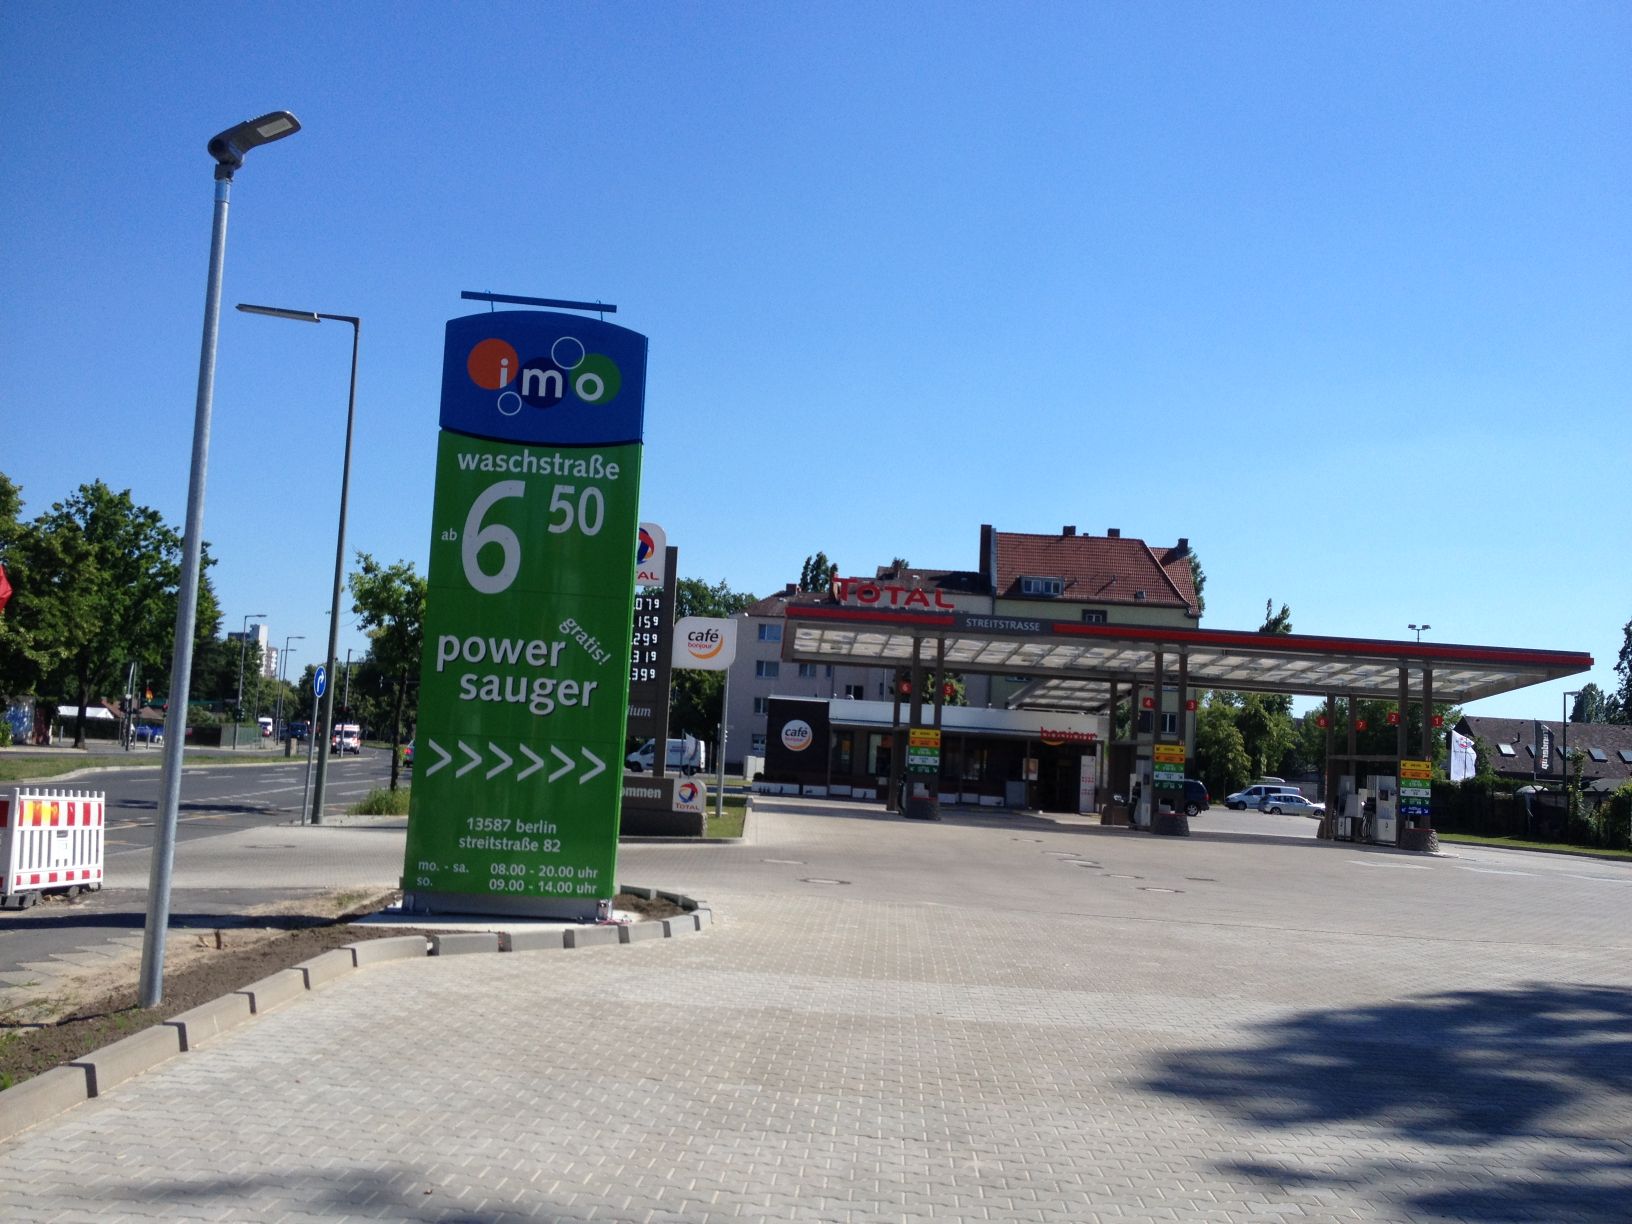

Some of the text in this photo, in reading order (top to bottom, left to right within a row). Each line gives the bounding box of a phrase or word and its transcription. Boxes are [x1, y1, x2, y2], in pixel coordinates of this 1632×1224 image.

[499, 358, 605, 401] imo
[457, 449, 620, 480] waschstraße
[441, 480, 605, 594] ab 6 50
[833, 577, 955, 609] TOTAL
[965, 618, 1041, 631] STREITSTRASSE
[559, 618, 611, 666] gratis!
[687, 628, 720, 643] café
[436, 634, 567, 673] power
[687, 642, 712, 650] bonjour
[459, 673, 598, 715] sauger
[784, 726, 808, 738] café
[675, 802, 700, 810] TOTAL
[466, 817, 557, 834] 13587 berlin
[458, 835, 561, 853] streitstraße 82
[418, 860, 440, 871] mo.
[452, 862, 469, 873] sa.
[490, 863, 527, 876] 08.00
[537, 865, 575, 878] 20.00
[577, 866, 598, 879] uhr
[416, 875, 433, 887] so.
[488, 879, 525, 891] 09.00
[537, 881, 574, 894] 14.00
[576, 882, 597, 894] uhr
